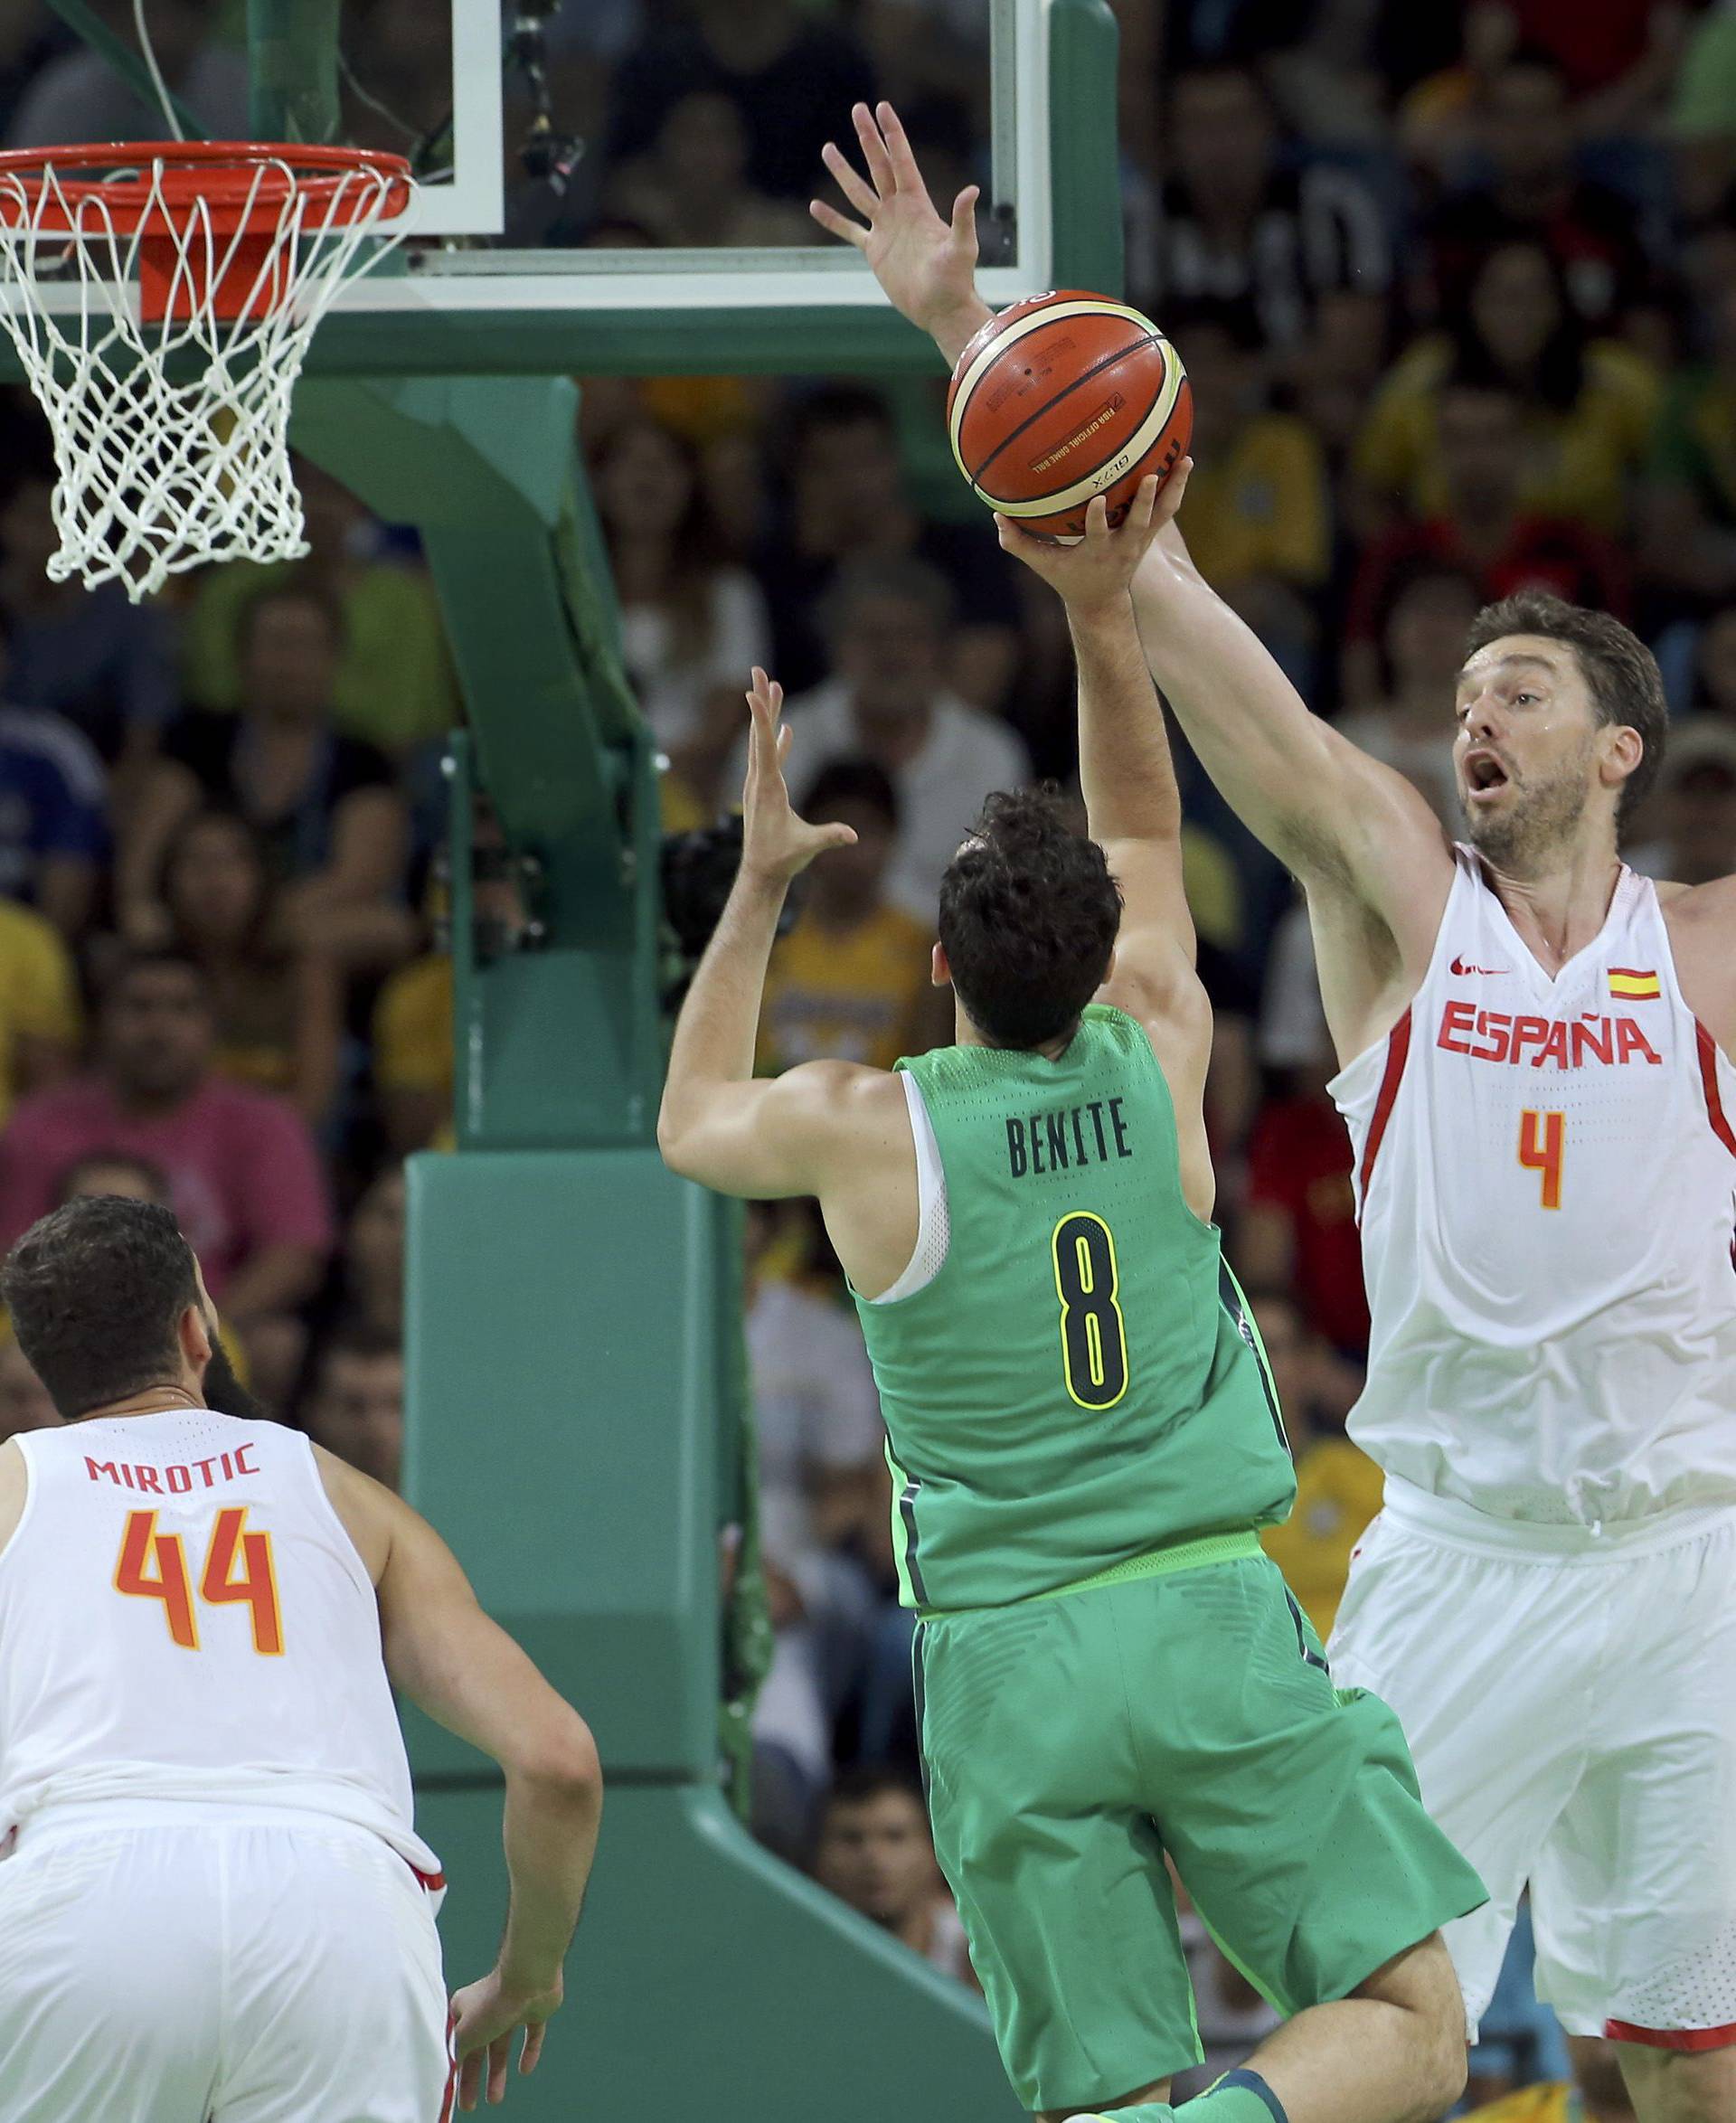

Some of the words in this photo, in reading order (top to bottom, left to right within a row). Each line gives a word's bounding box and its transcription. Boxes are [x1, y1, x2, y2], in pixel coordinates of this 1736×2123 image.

[1068, 420, 1100, 448] OFFICIAL
[1097, 407, 1116, 424] FIBA
[1032, 458, 1050, 474] BALL
[1048, 445, 1071, 463] GAME
[1437, 1000, 1662, 1071] ESPAÑA
[1006, 1097, 1133, 1178] BENITE
[1516, 1109, 1567, 1211] 4
[1052, 1209, 1130, 1414] 8
[84, 1443, 260, 1495] MIROTIC
[112, 1505, 285, 1656] 44
